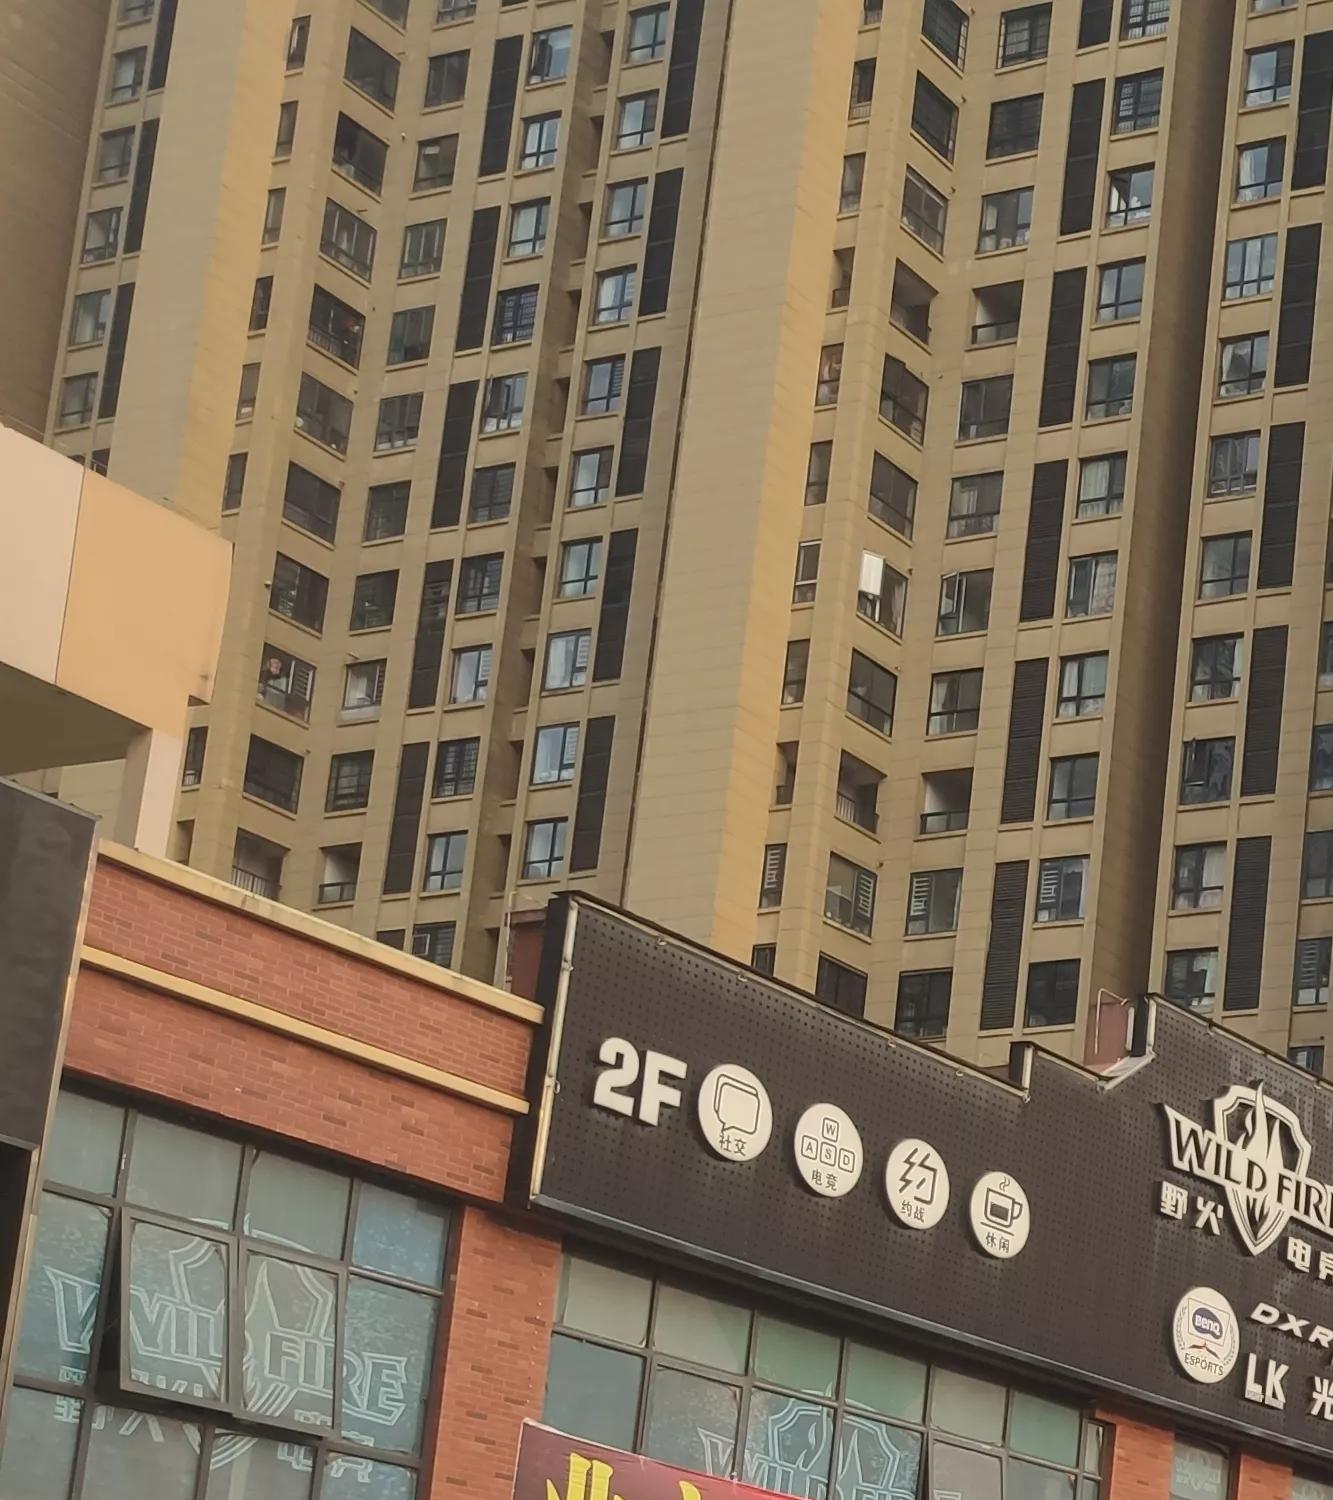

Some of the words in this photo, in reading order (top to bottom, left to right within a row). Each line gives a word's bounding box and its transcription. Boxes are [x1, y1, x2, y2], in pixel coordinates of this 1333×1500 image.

[593, 1037, 688, 1127] 2F
[718, 1133, 748, 1156] 社交
[1166, 1108, 1268, 1195] WILD
[811, 1169, 839, 1192] 电竞
[899, 1147, 938, 1206] 约
[899, 1200, 926, 1224] 约战
[1160, 1180, 1224, 1236] 野火
[984, 1231, 1010, 1254] 休闲
[1184, 1352, 1224, 1377] ESPORTS
[1244, 1352, 1290, 1411] LK
